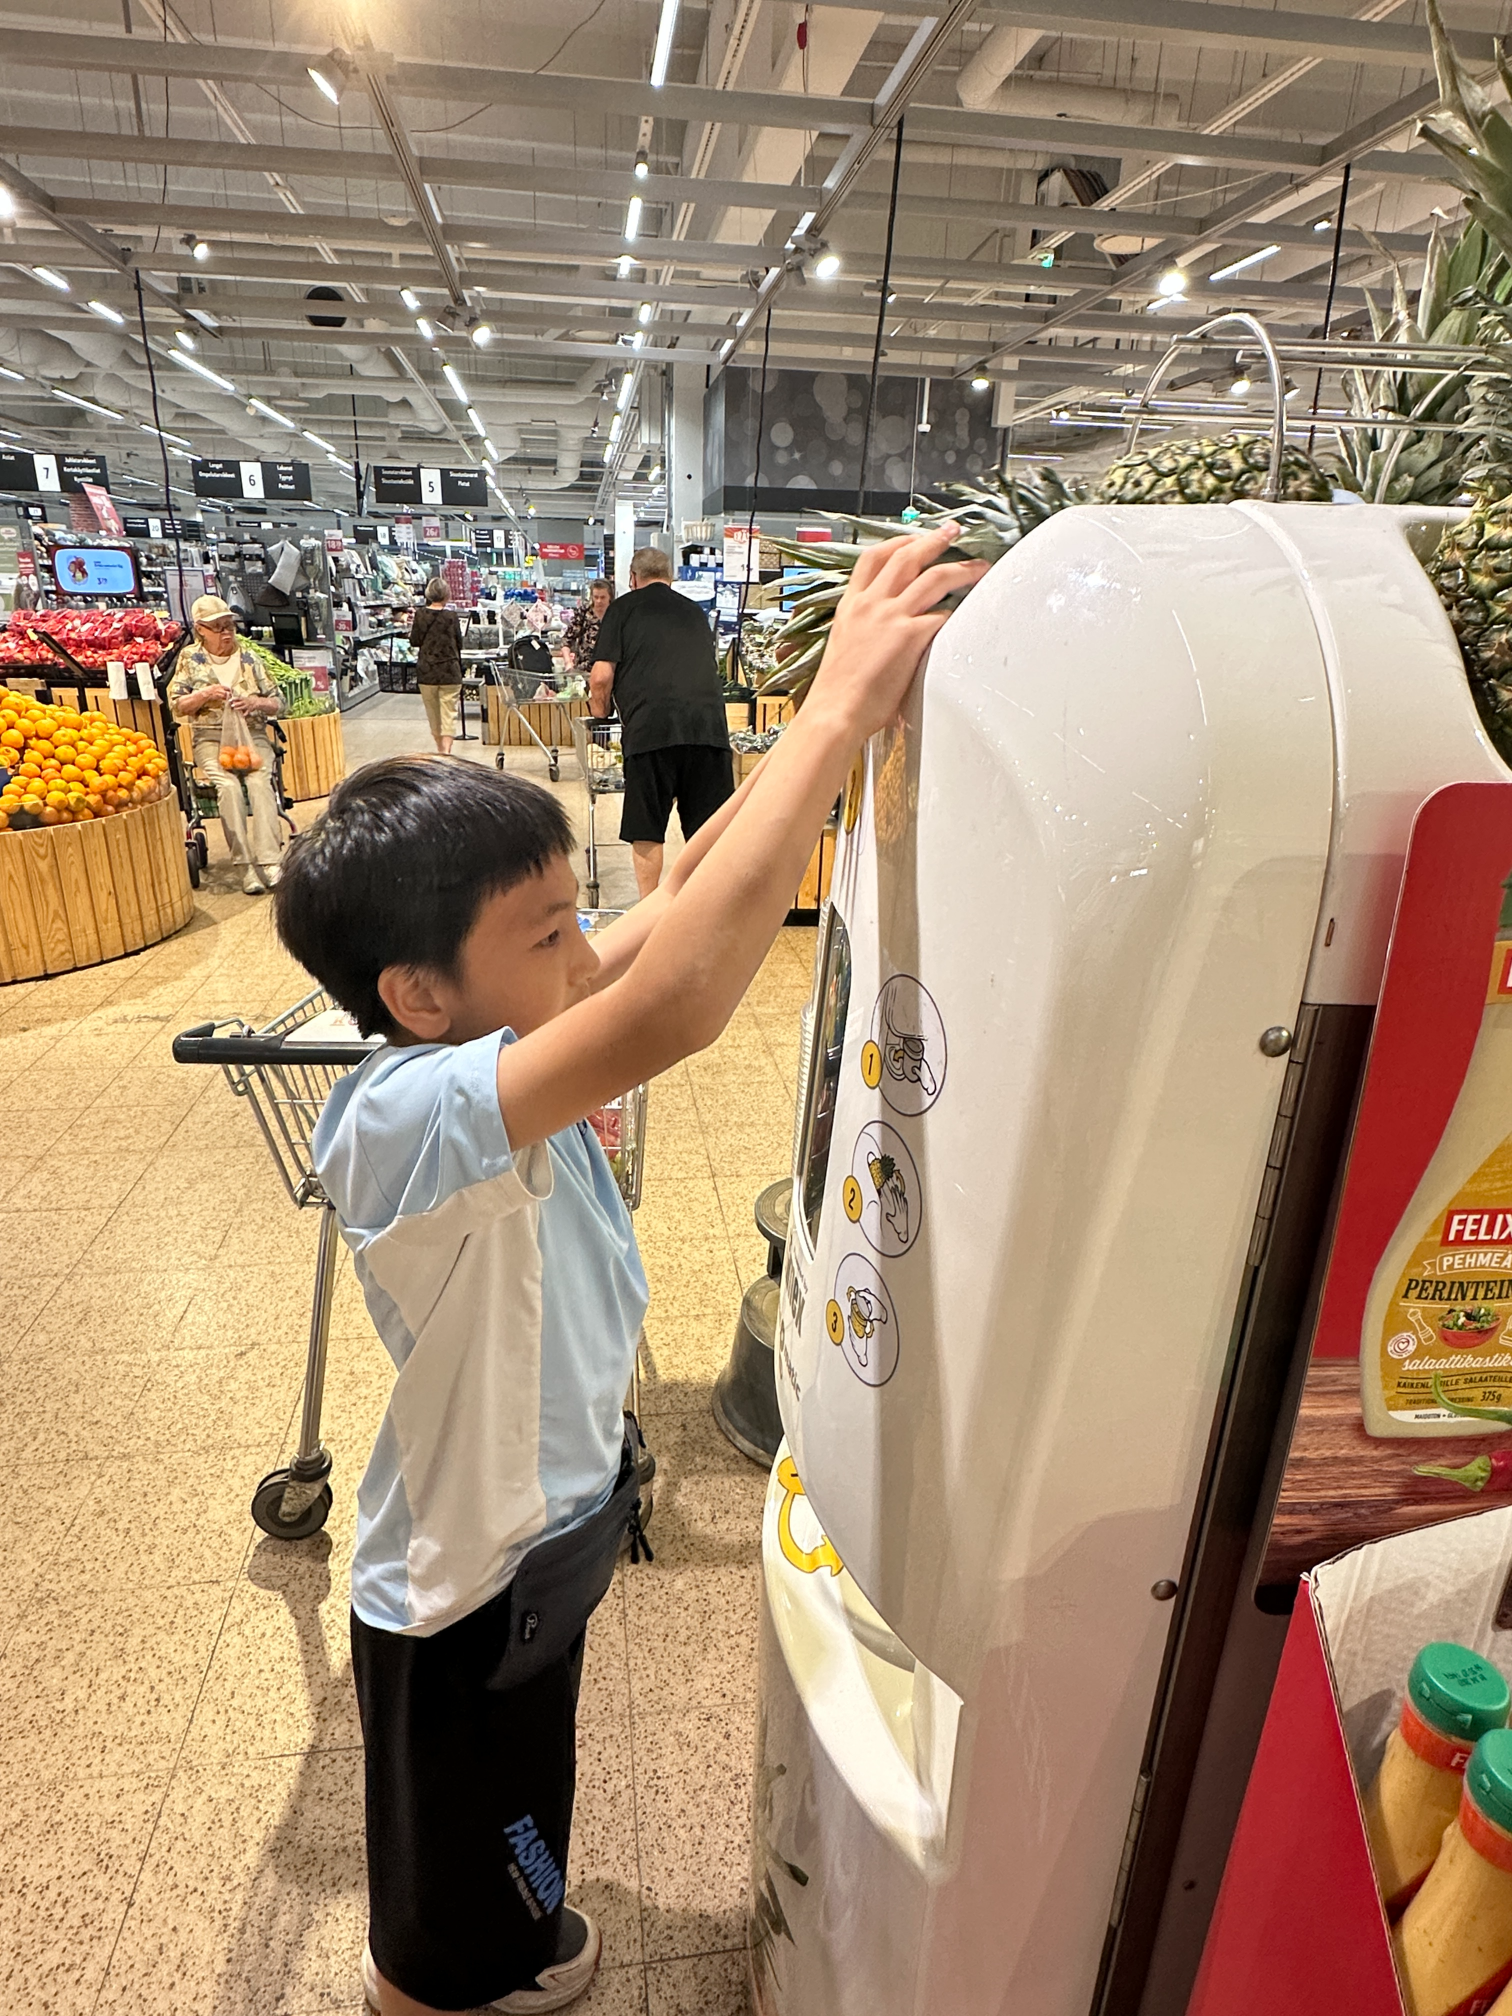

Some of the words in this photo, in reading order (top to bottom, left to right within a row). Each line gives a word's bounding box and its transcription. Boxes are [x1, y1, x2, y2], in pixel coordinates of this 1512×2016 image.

[43, 467, 49, 479] 7
[248, 474, 256, 487] 6
[428, 481, 435, 493] 5
[868, 1053, 874, 1076] 1
[849, 1187, 856, 1211] 2
[831, 1311, 838, 1333] 3
[1396, 1379, 1460, 1389] KAIKENLSILLE
[1480, 1390, 1503, 1403] 375g
[503, 1813, 565, 1915] FASHION
